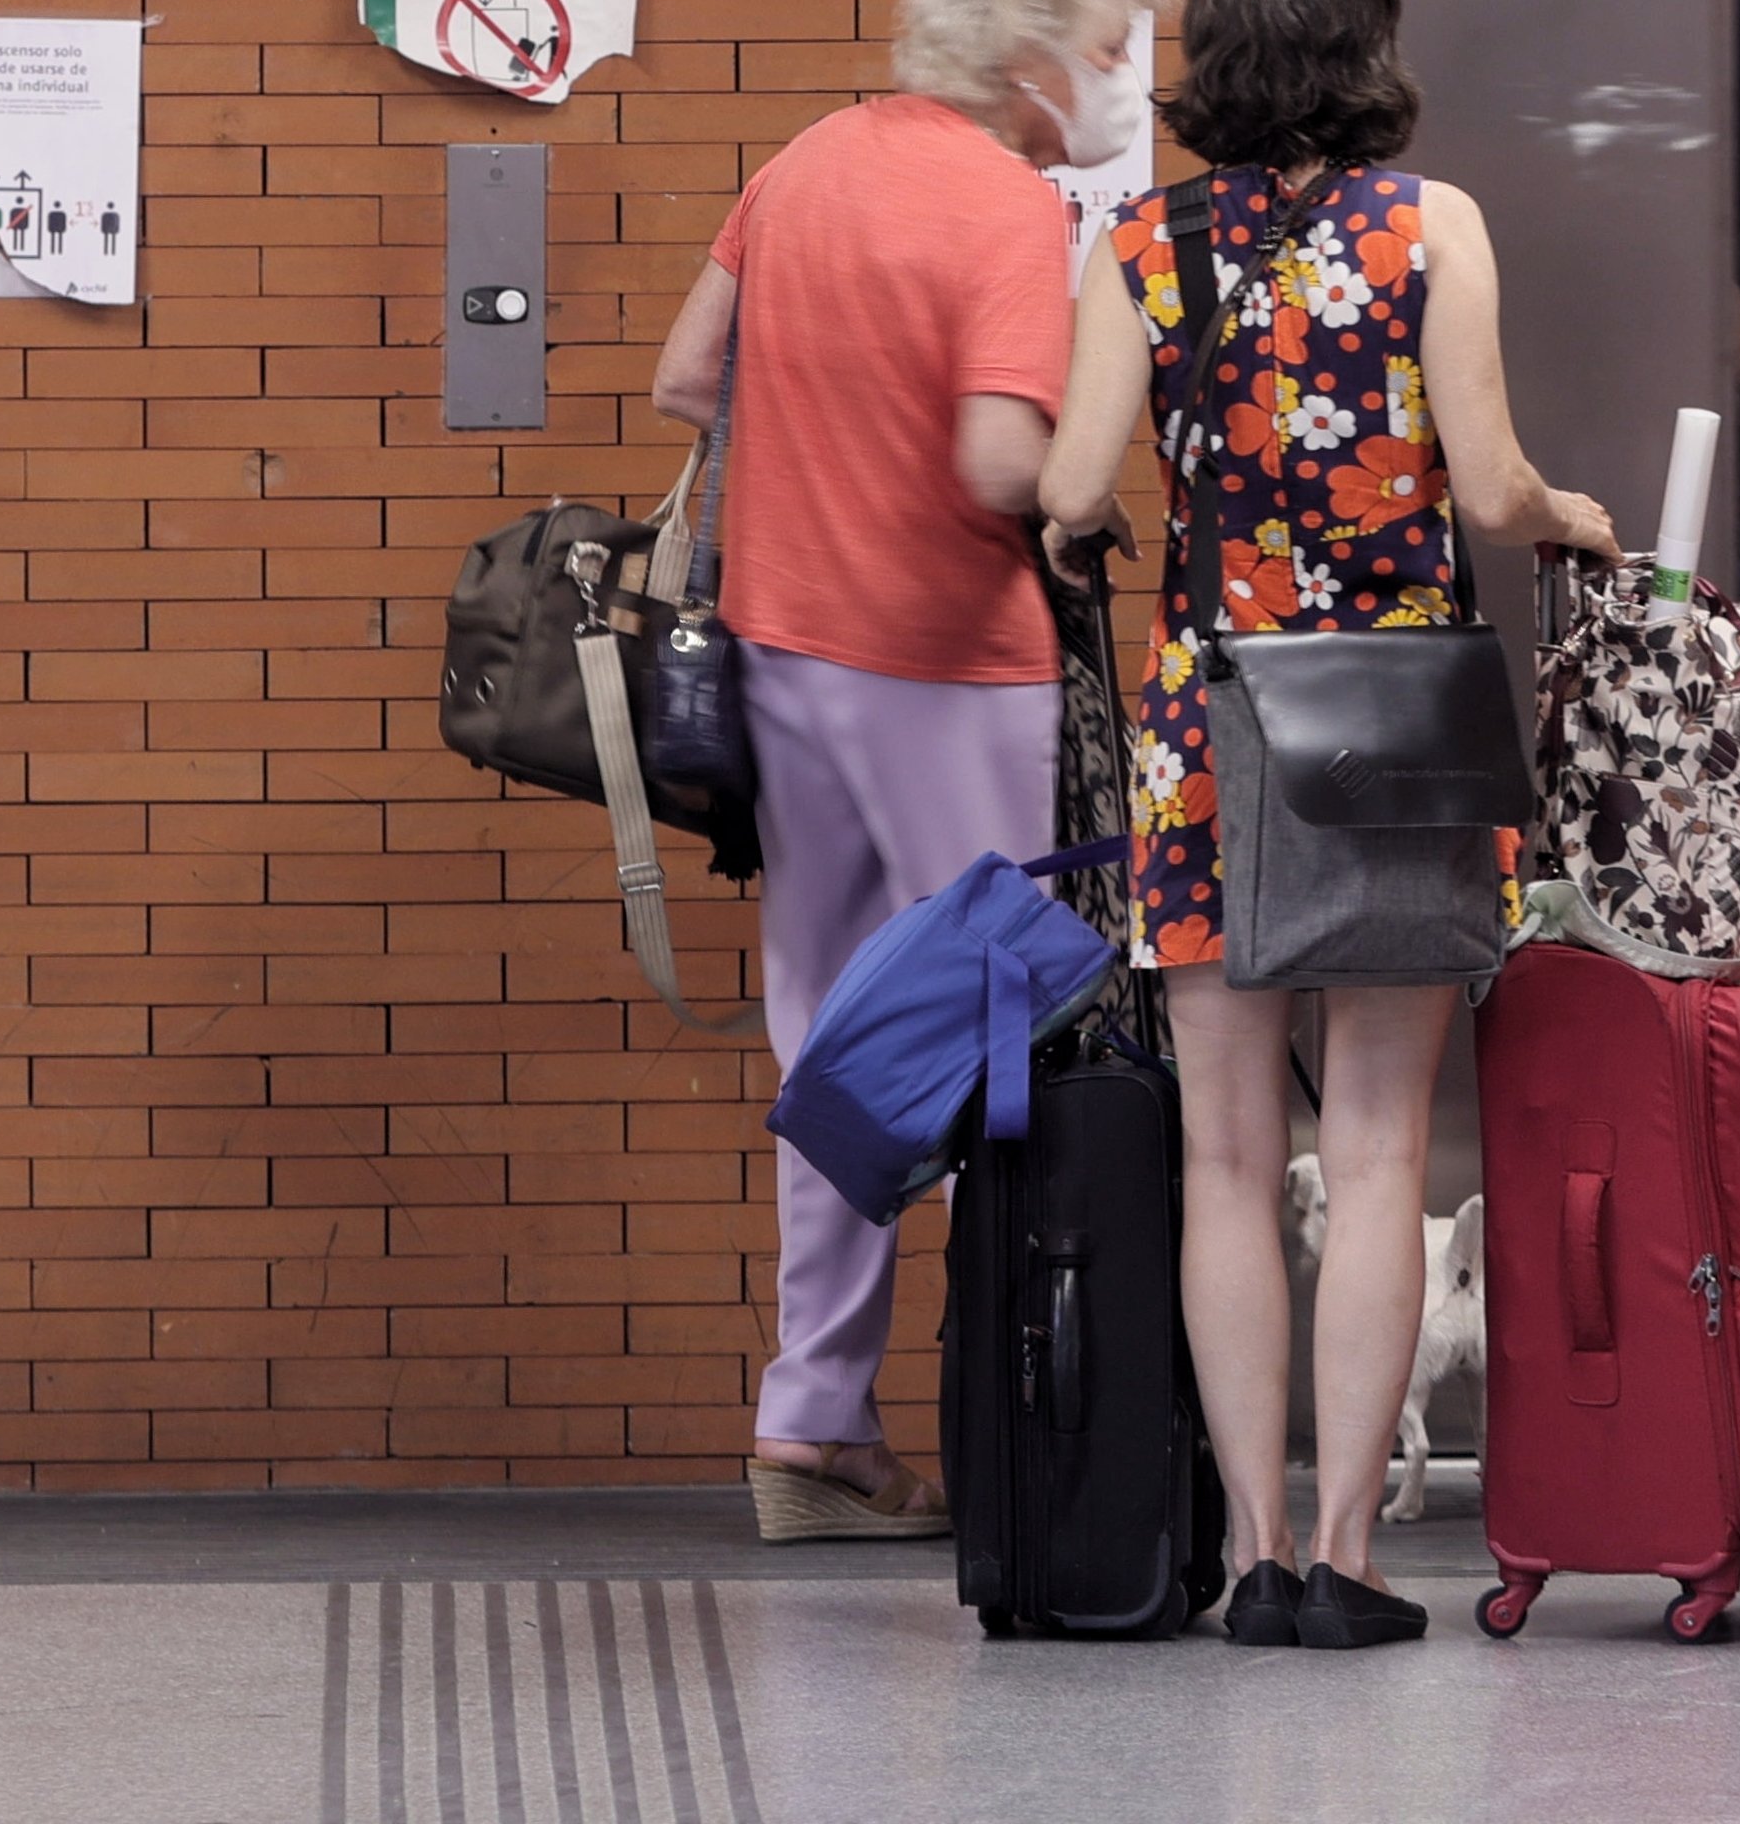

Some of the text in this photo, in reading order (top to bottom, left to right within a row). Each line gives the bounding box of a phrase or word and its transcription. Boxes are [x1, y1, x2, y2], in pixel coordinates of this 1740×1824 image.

[54, 45, 82, 58] solo
[21, 64, 65, 75] usarse
[70, 63, 88, 76] de
[18, 79, 89, 93] individual
